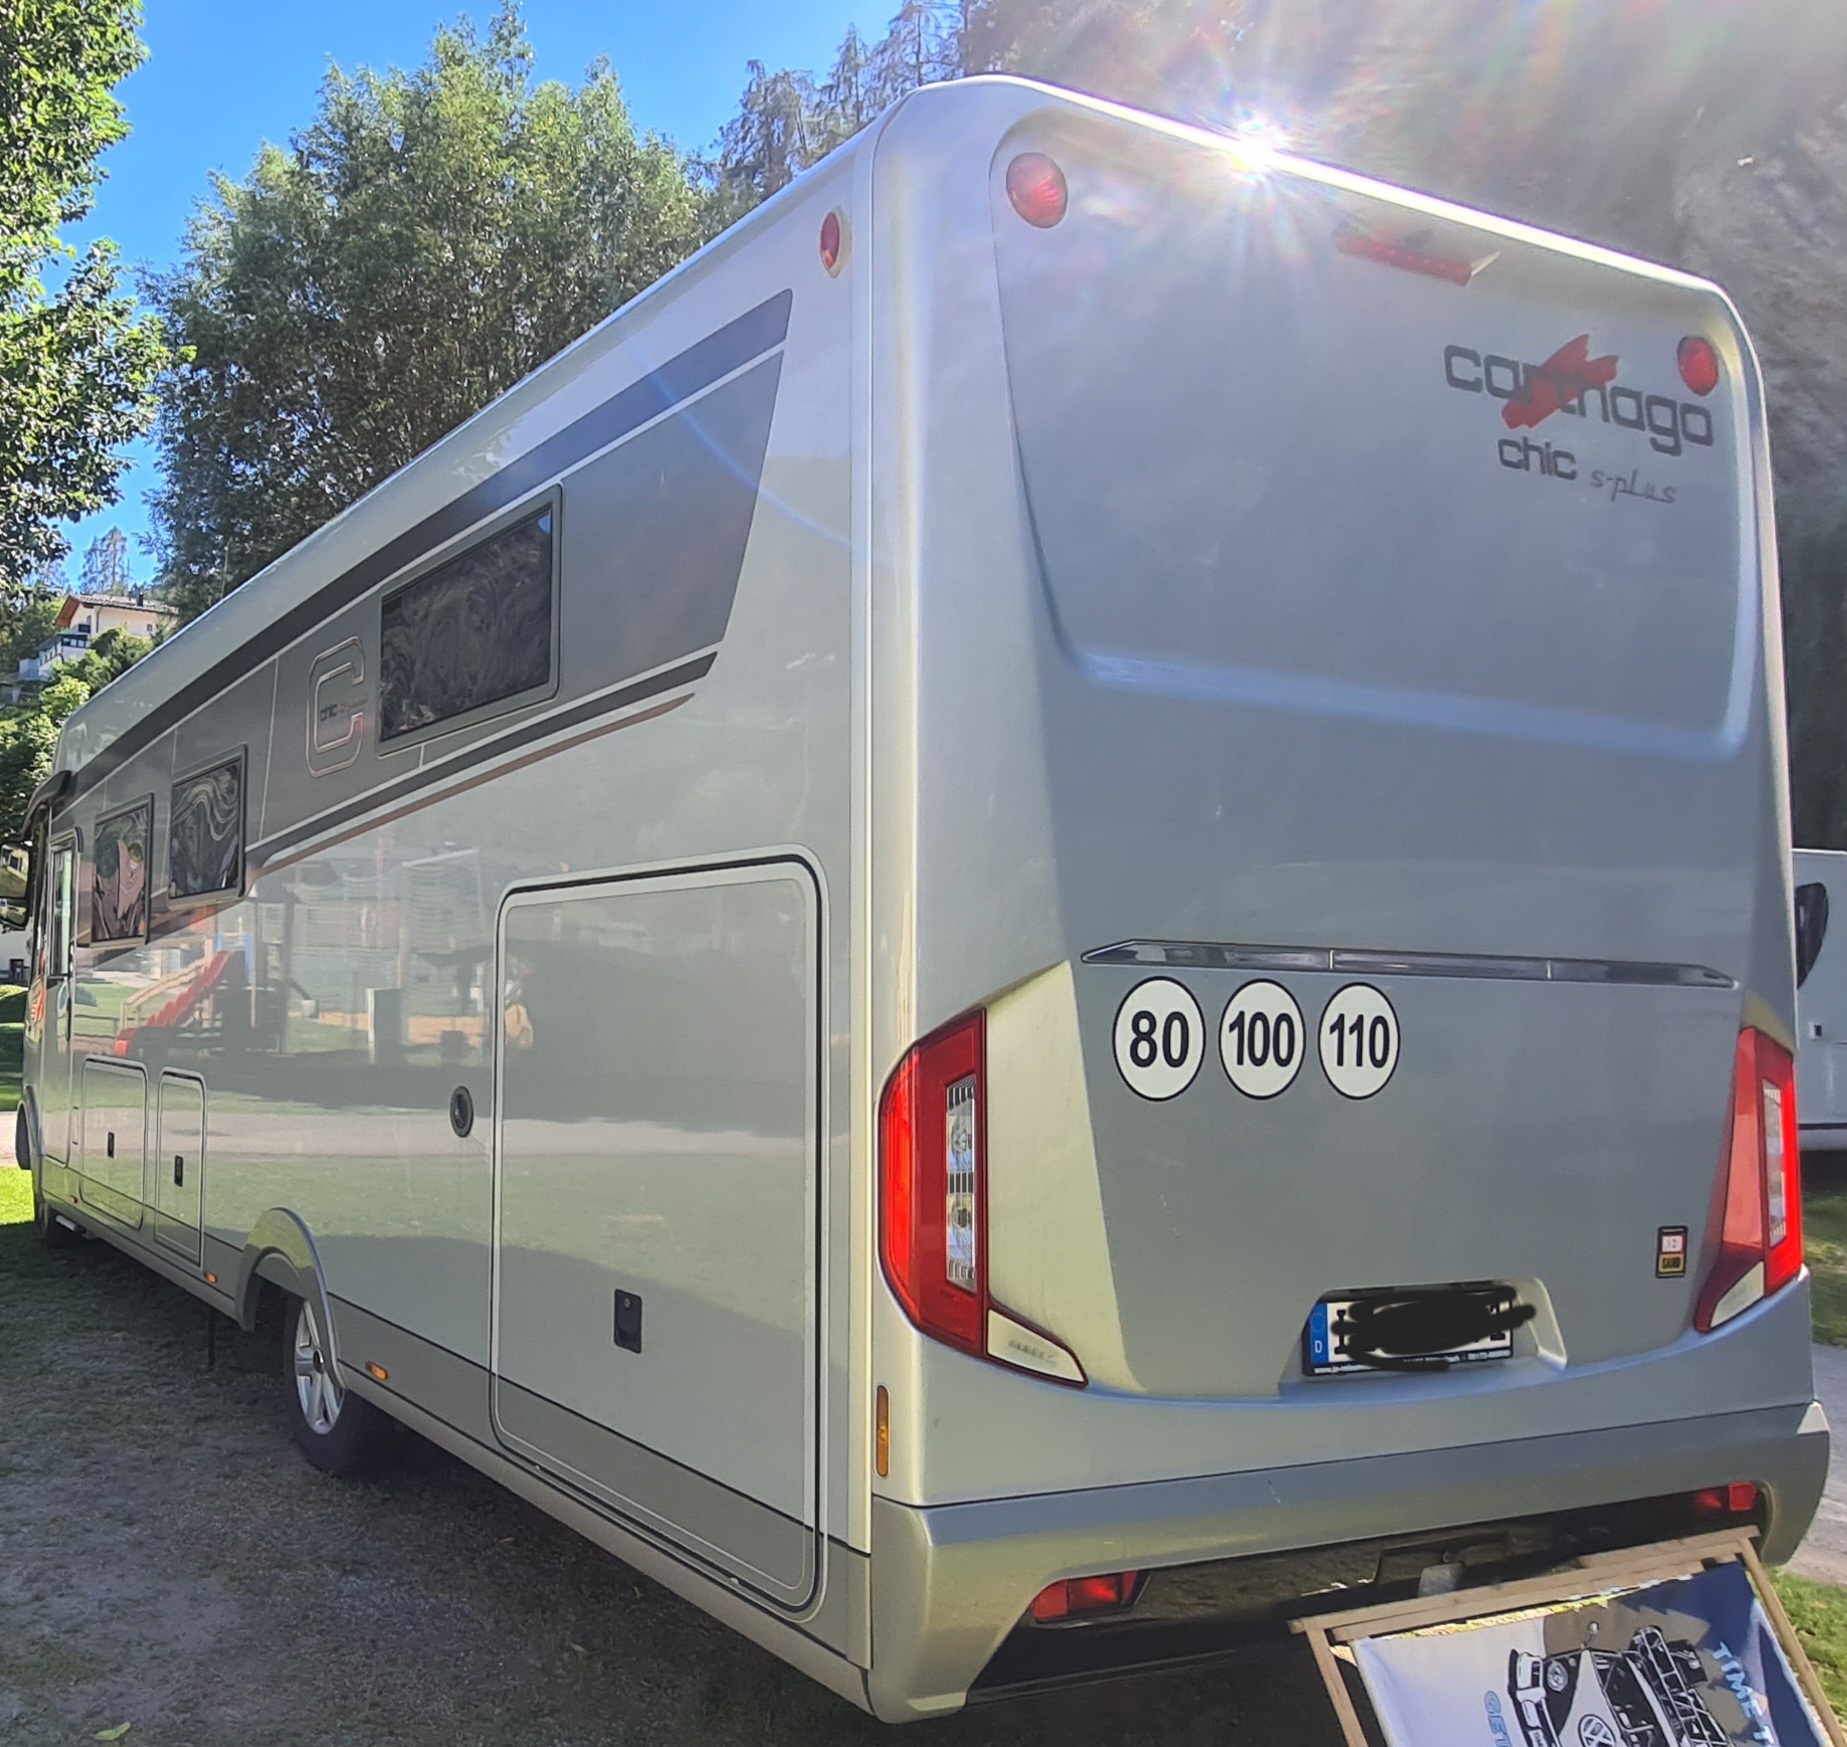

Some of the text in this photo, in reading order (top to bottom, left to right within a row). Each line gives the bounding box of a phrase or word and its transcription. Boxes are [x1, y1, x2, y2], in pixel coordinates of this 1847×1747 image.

[1498, 436, 1676, 503] chic s-plus
[1130, 1011, 1189, 1068] 80
[1229, 1010, 1295, 1067] 100
[1329, 1013, 1390, 1068] 110
[1314, 1340, 1323, 1353] D
[1712, 1640, 1775, 1747] TIME T
